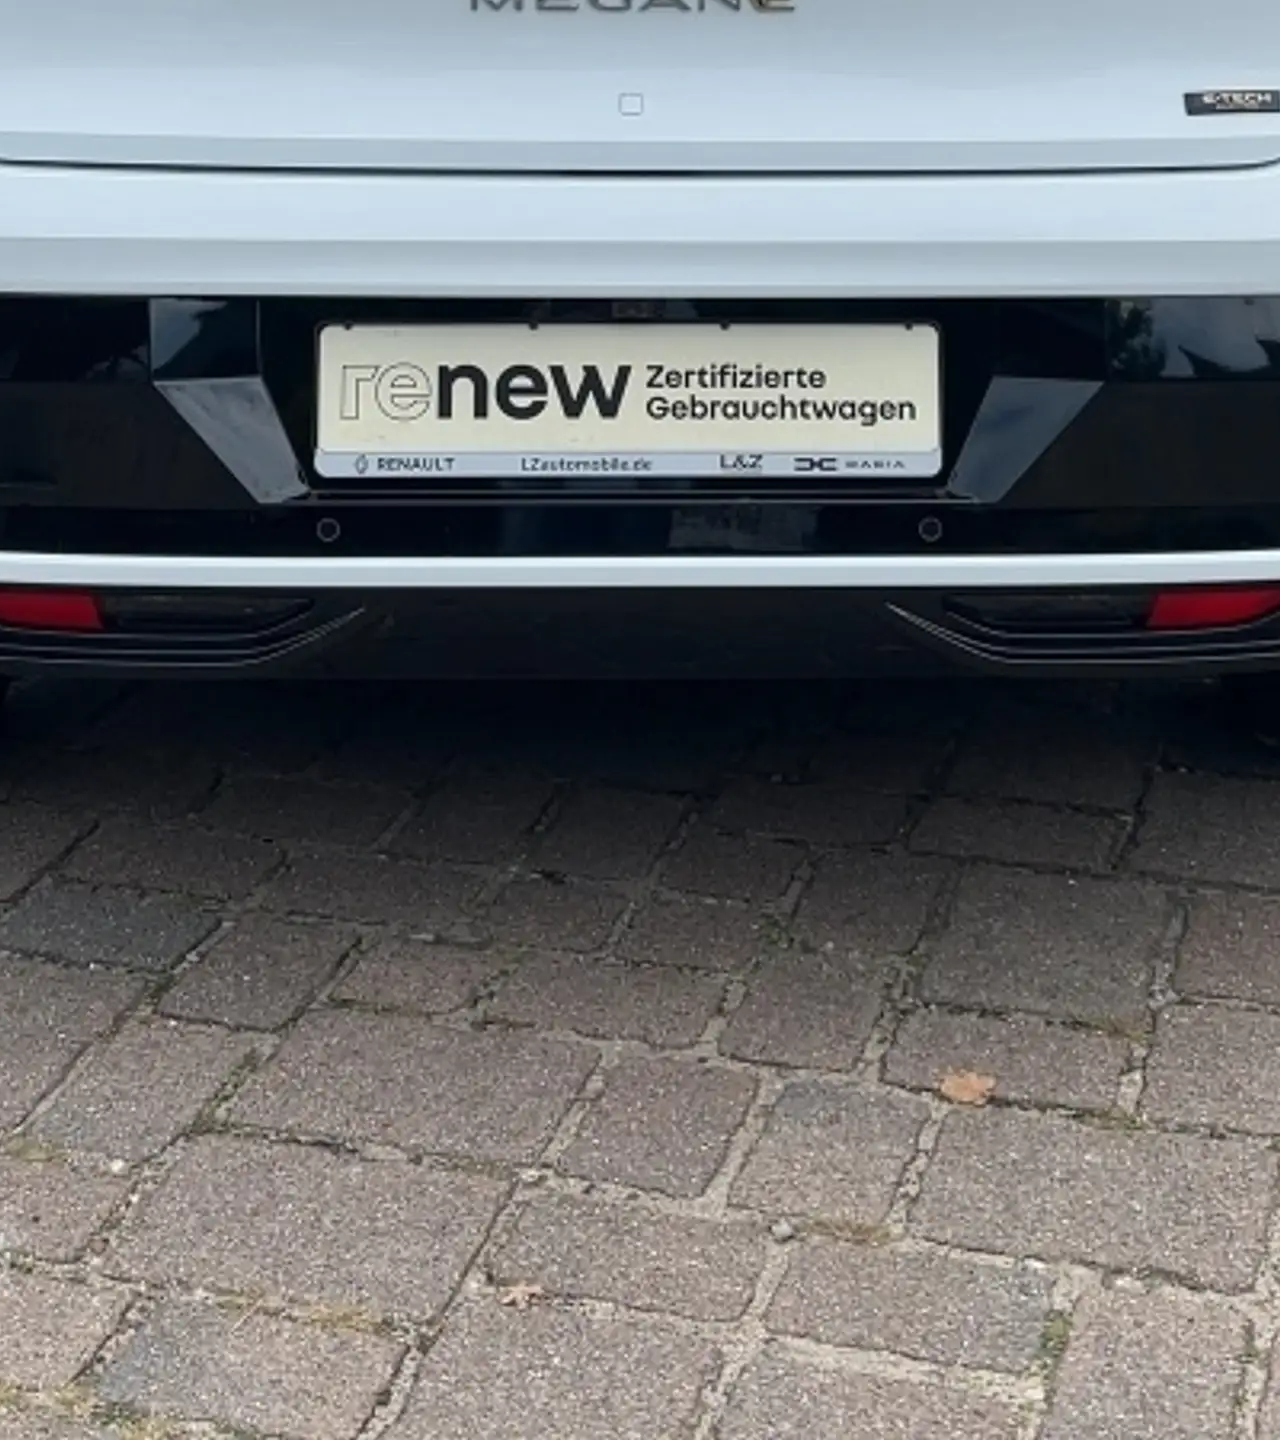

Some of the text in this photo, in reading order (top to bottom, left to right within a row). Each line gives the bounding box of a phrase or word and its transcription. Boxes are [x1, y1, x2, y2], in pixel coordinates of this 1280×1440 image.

[645, 363, 828, 389] Zertifizierte
[339, 361, 632, 421] renew
[645, 393, 918, 427] Gebrauchtwagen
[376, 456, 456, 472] RENAULT
[520, 456, 652, 472] LZautomobile.de
[719, 453, 764, 470] L&Z
